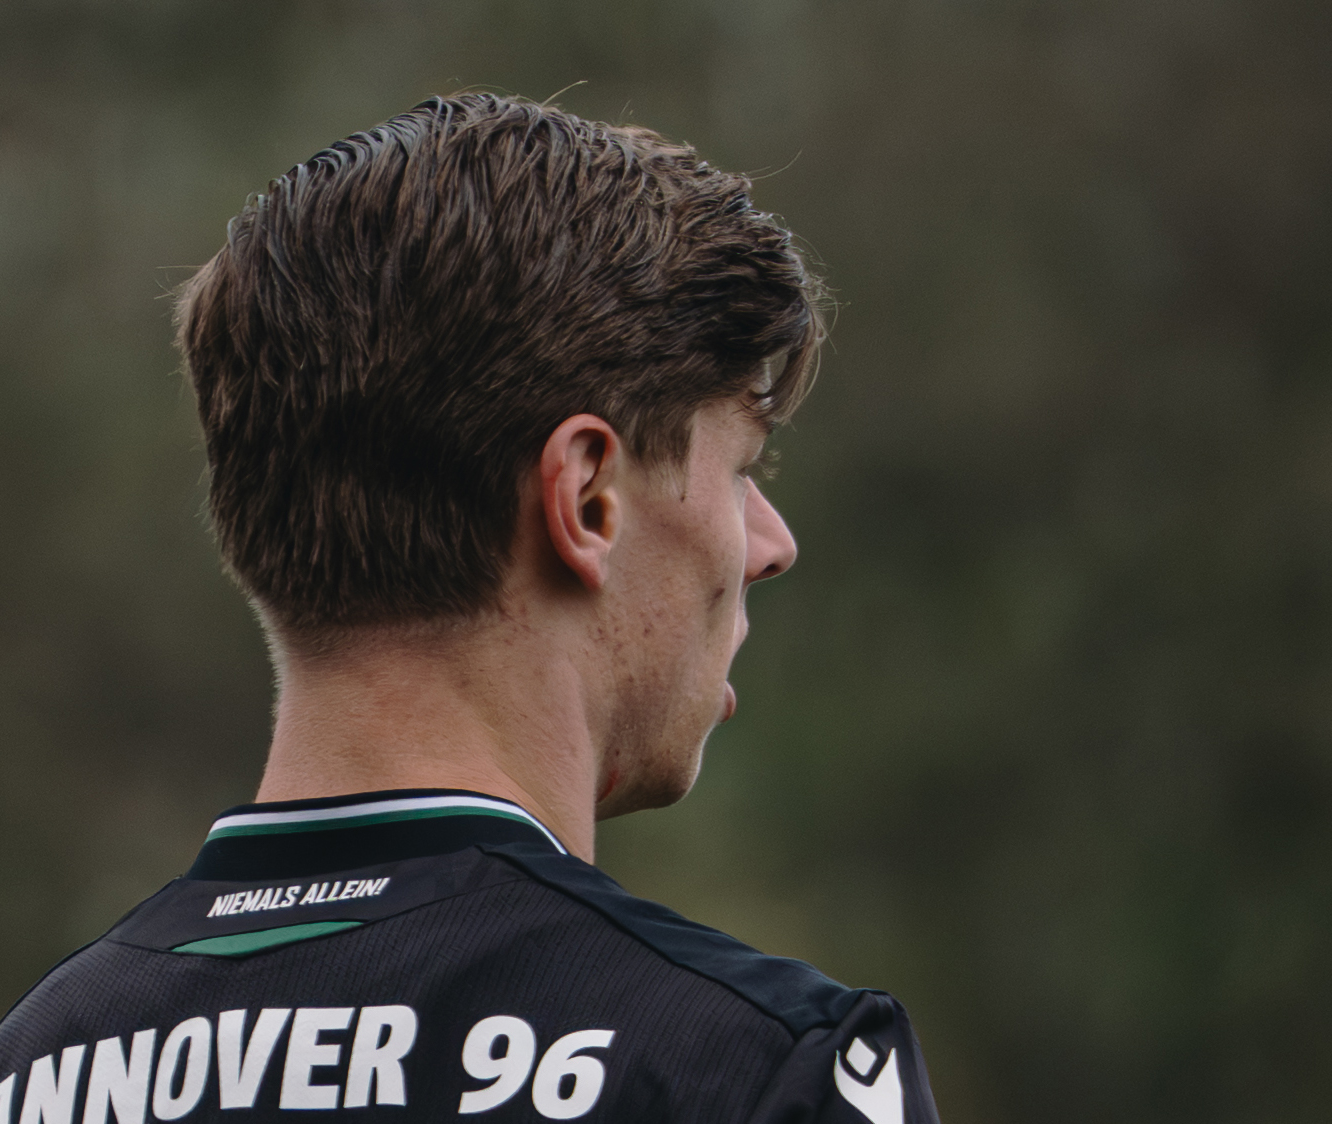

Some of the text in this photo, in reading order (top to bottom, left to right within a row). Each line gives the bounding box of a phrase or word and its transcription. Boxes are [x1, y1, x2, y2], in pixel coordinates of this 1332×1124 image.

[207, 877, 391, 918] NIEMALS ALLEIN!
[458, 1015, 616, 1120] 96
